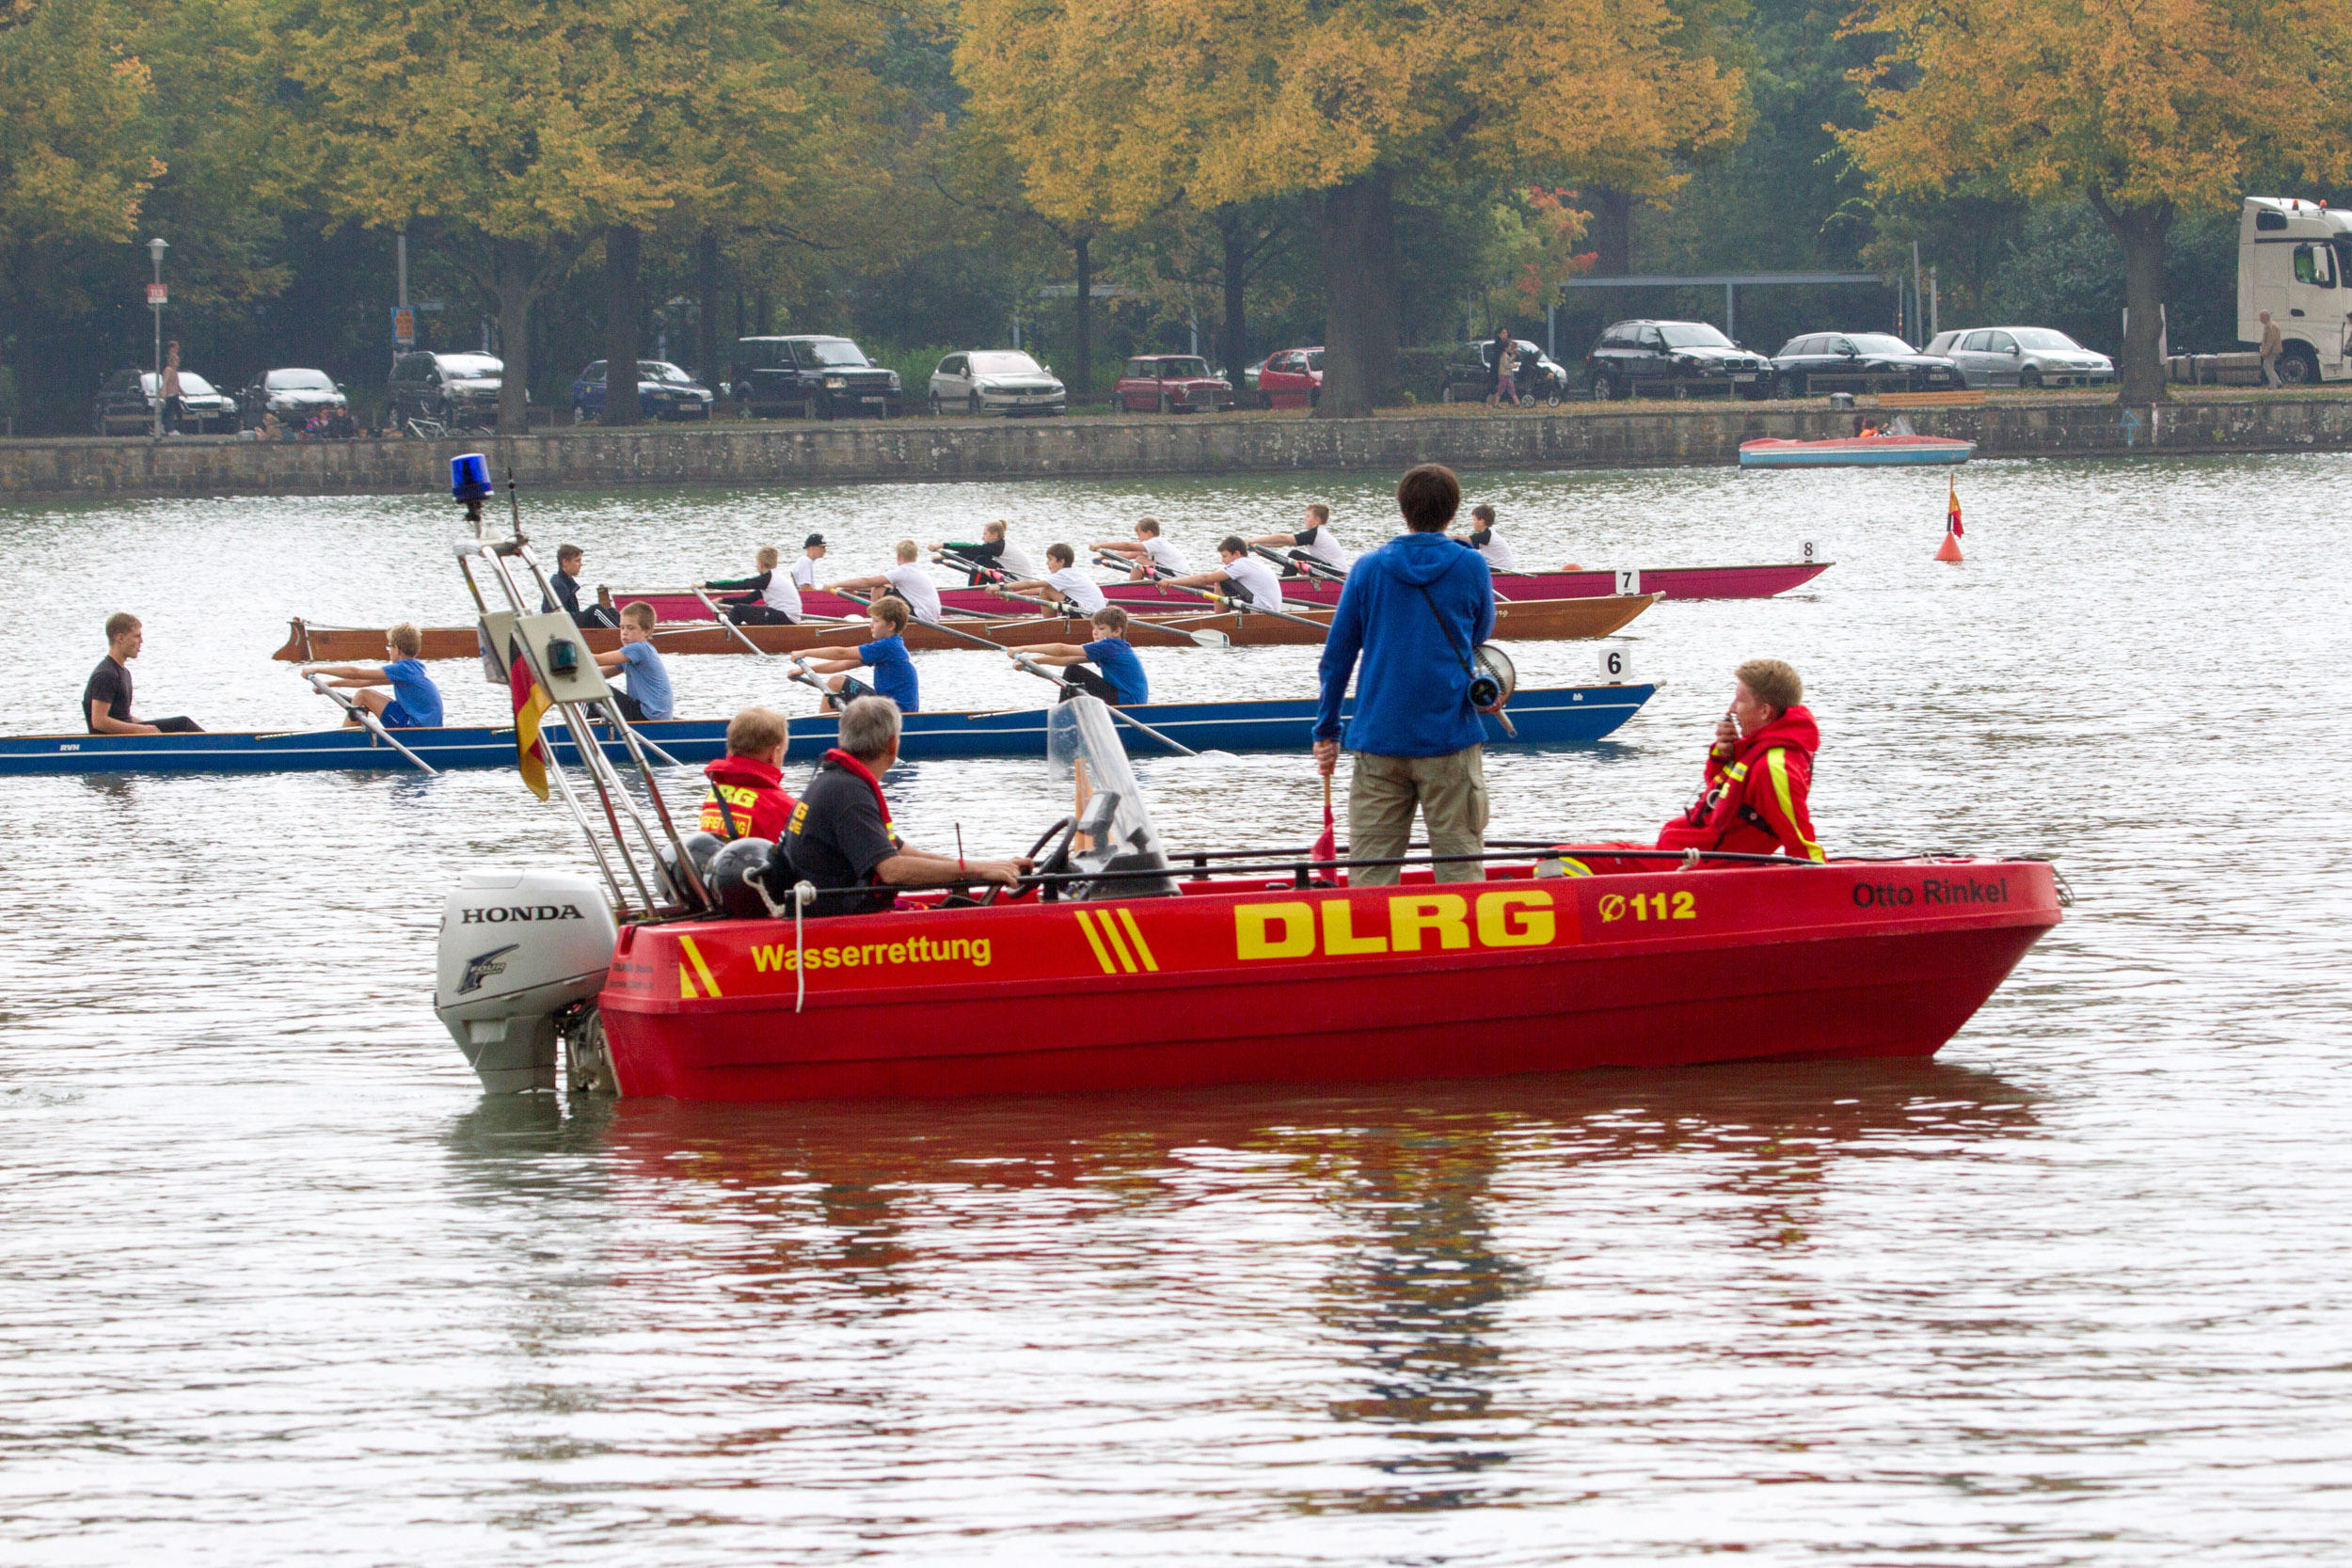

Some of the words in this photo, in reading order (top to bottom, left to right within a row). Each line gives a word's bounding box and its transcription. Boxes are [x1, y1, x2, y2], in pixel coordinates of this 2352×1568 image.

[1804, 542, 1813, 557] 8
[1622, 572, 1632, 589] 7
[1607, 652, 1622, 675] 6
[1630, 891, 1697, 921] 112
[1852, 882, 1915, 909] Otto
[1923, 878, 2008, 905] Rinkel
[461, 905, 585, 924] HONDA
[1234, 890, 1556, 960] DLRG
[751, 936, 992, 973] Wasserrettung
